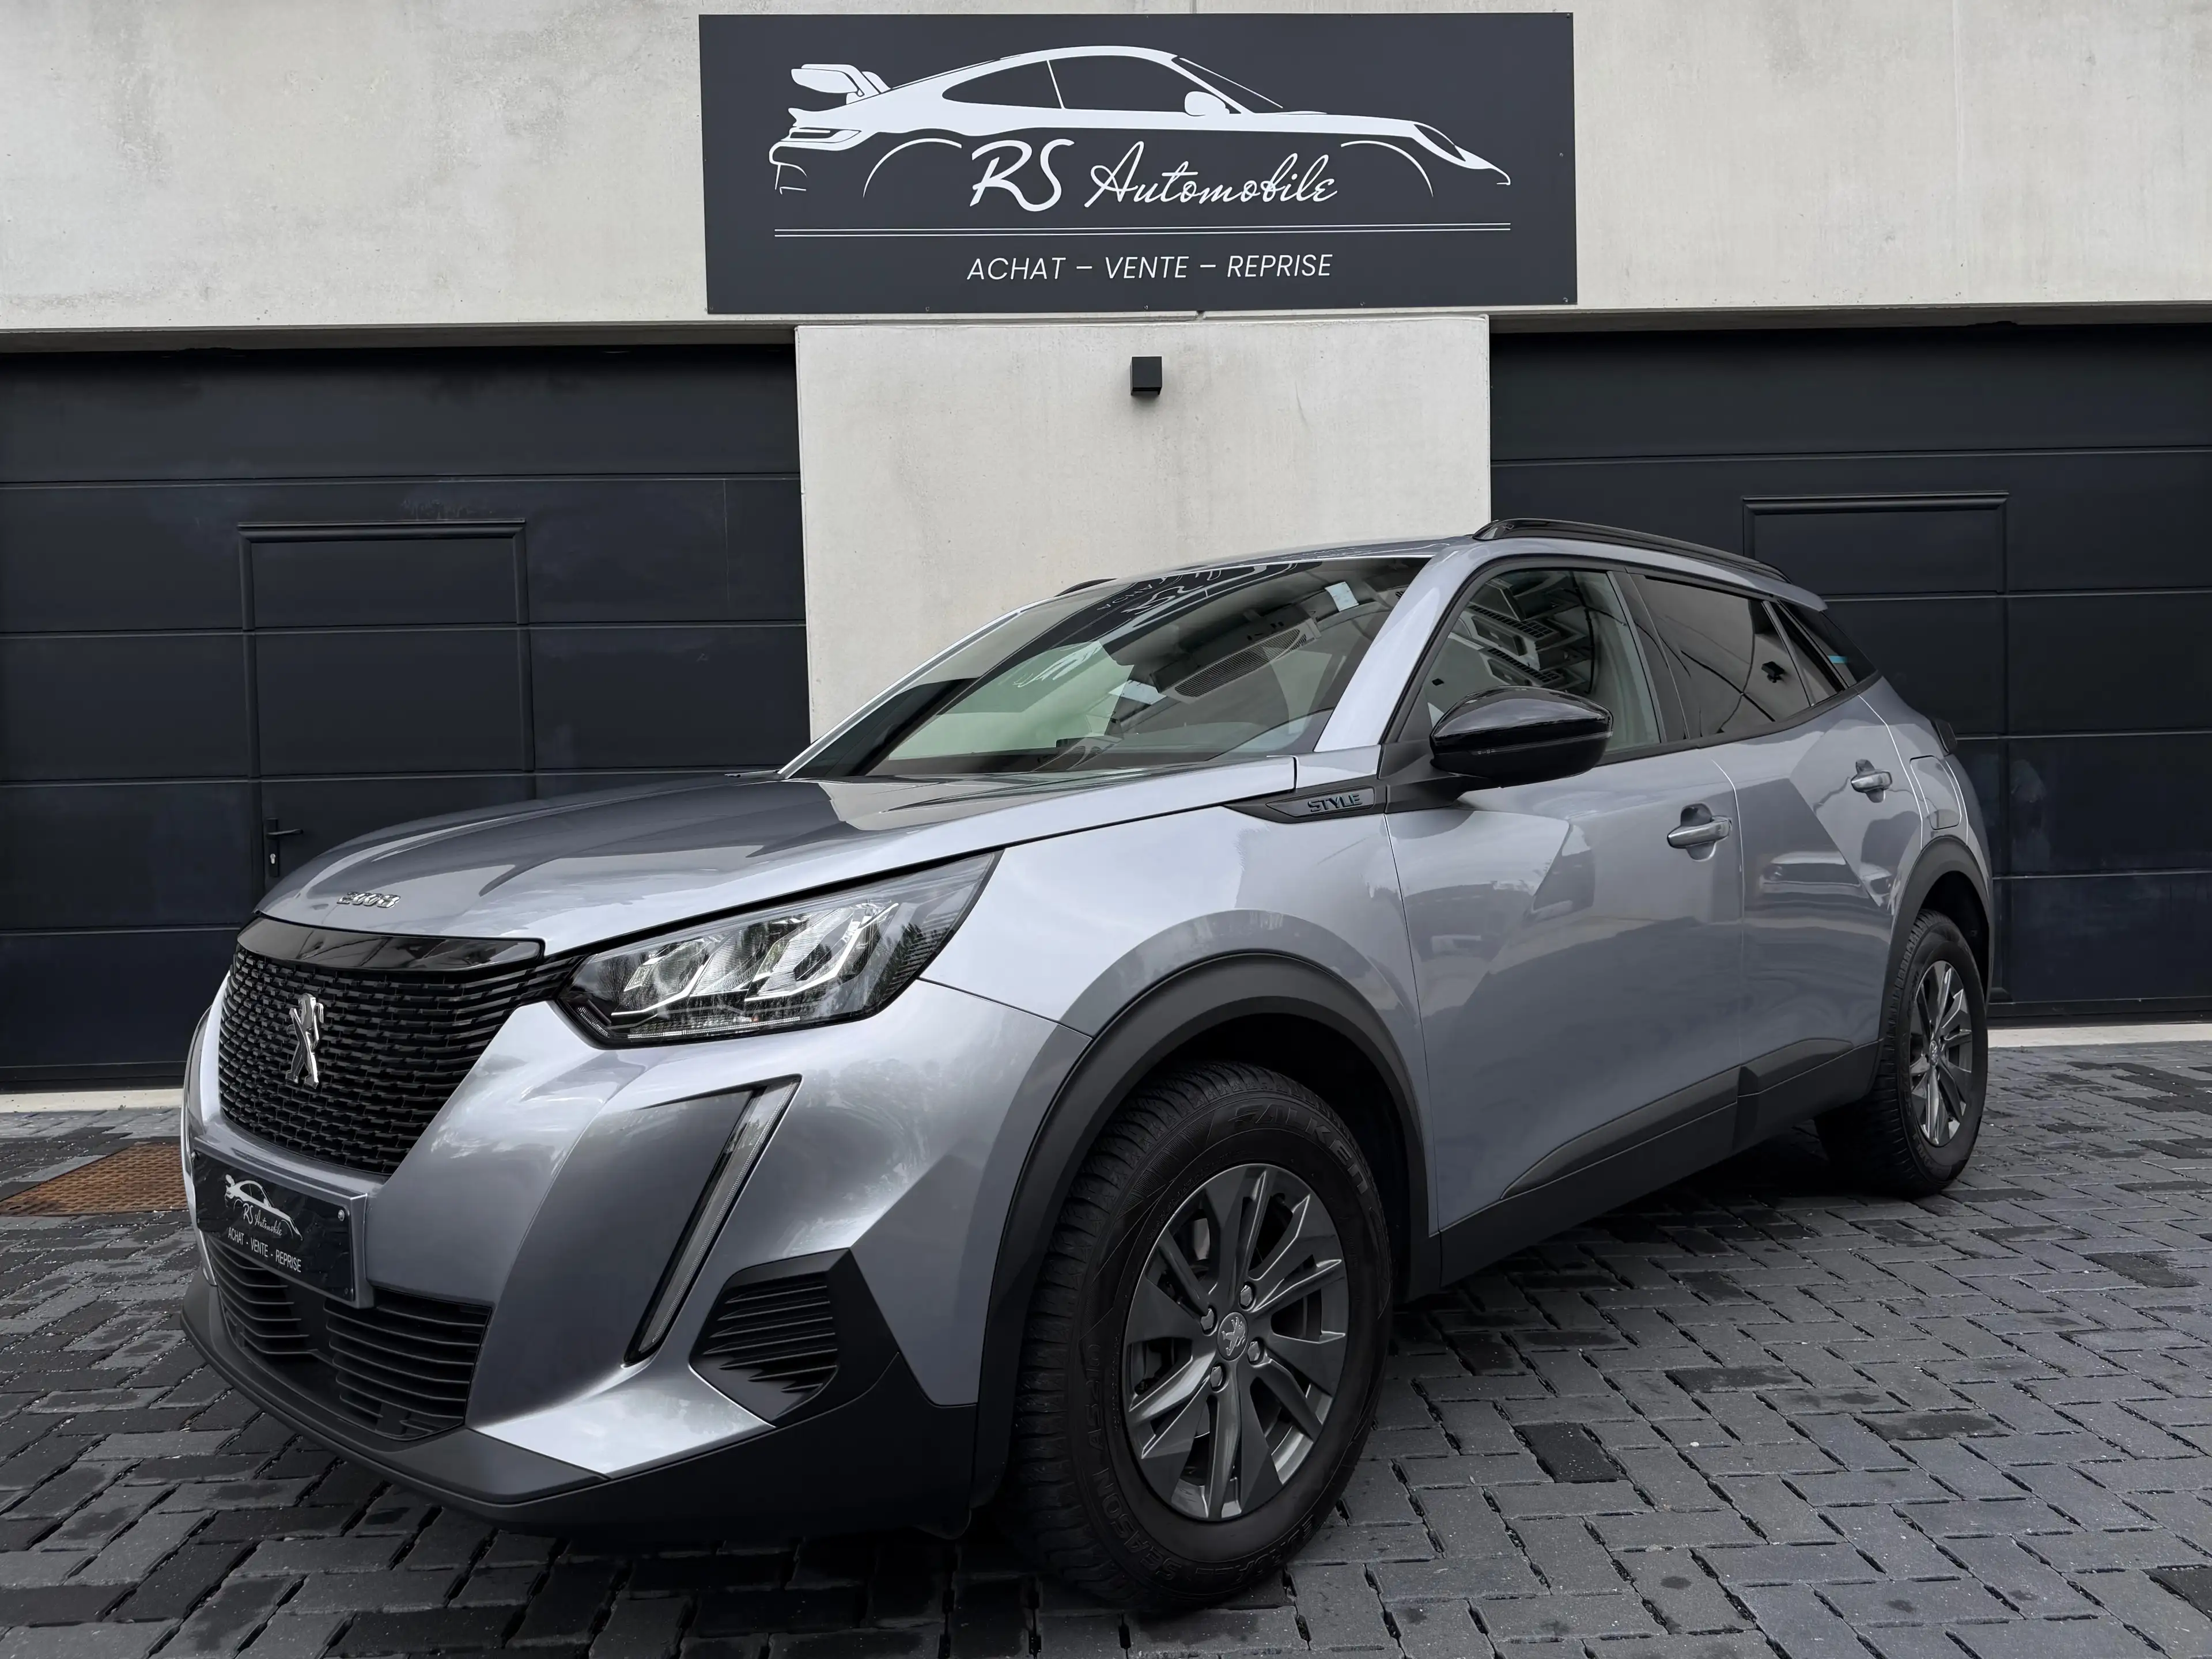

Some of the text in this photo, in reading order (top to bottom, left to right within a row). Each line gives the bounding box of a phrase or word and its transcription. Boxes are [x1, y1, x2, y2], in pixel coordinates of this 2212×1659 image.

[969, 138, 1338, 212] RS Automobile
[966, 257, 1067, 280] ACHAT
[1105, 256, 1189, 279] VENTE
[1227, 254, 1333, 278] REPRISE
[1307, 793, 1363, 812] STYLE
[336, 891, 401, 908] 2008
[1228, 1103, 1369, 1195] FALKEN
[243, 1203, 282, 1236] RS Automobile
[228, 1226, 244, 1245] ACHAT
[251, 1237, 269, 1257] VENTE
[275, 1249, 301, 1272] REPRISE
[1092, 1467, 1182, 1581] SEASON
